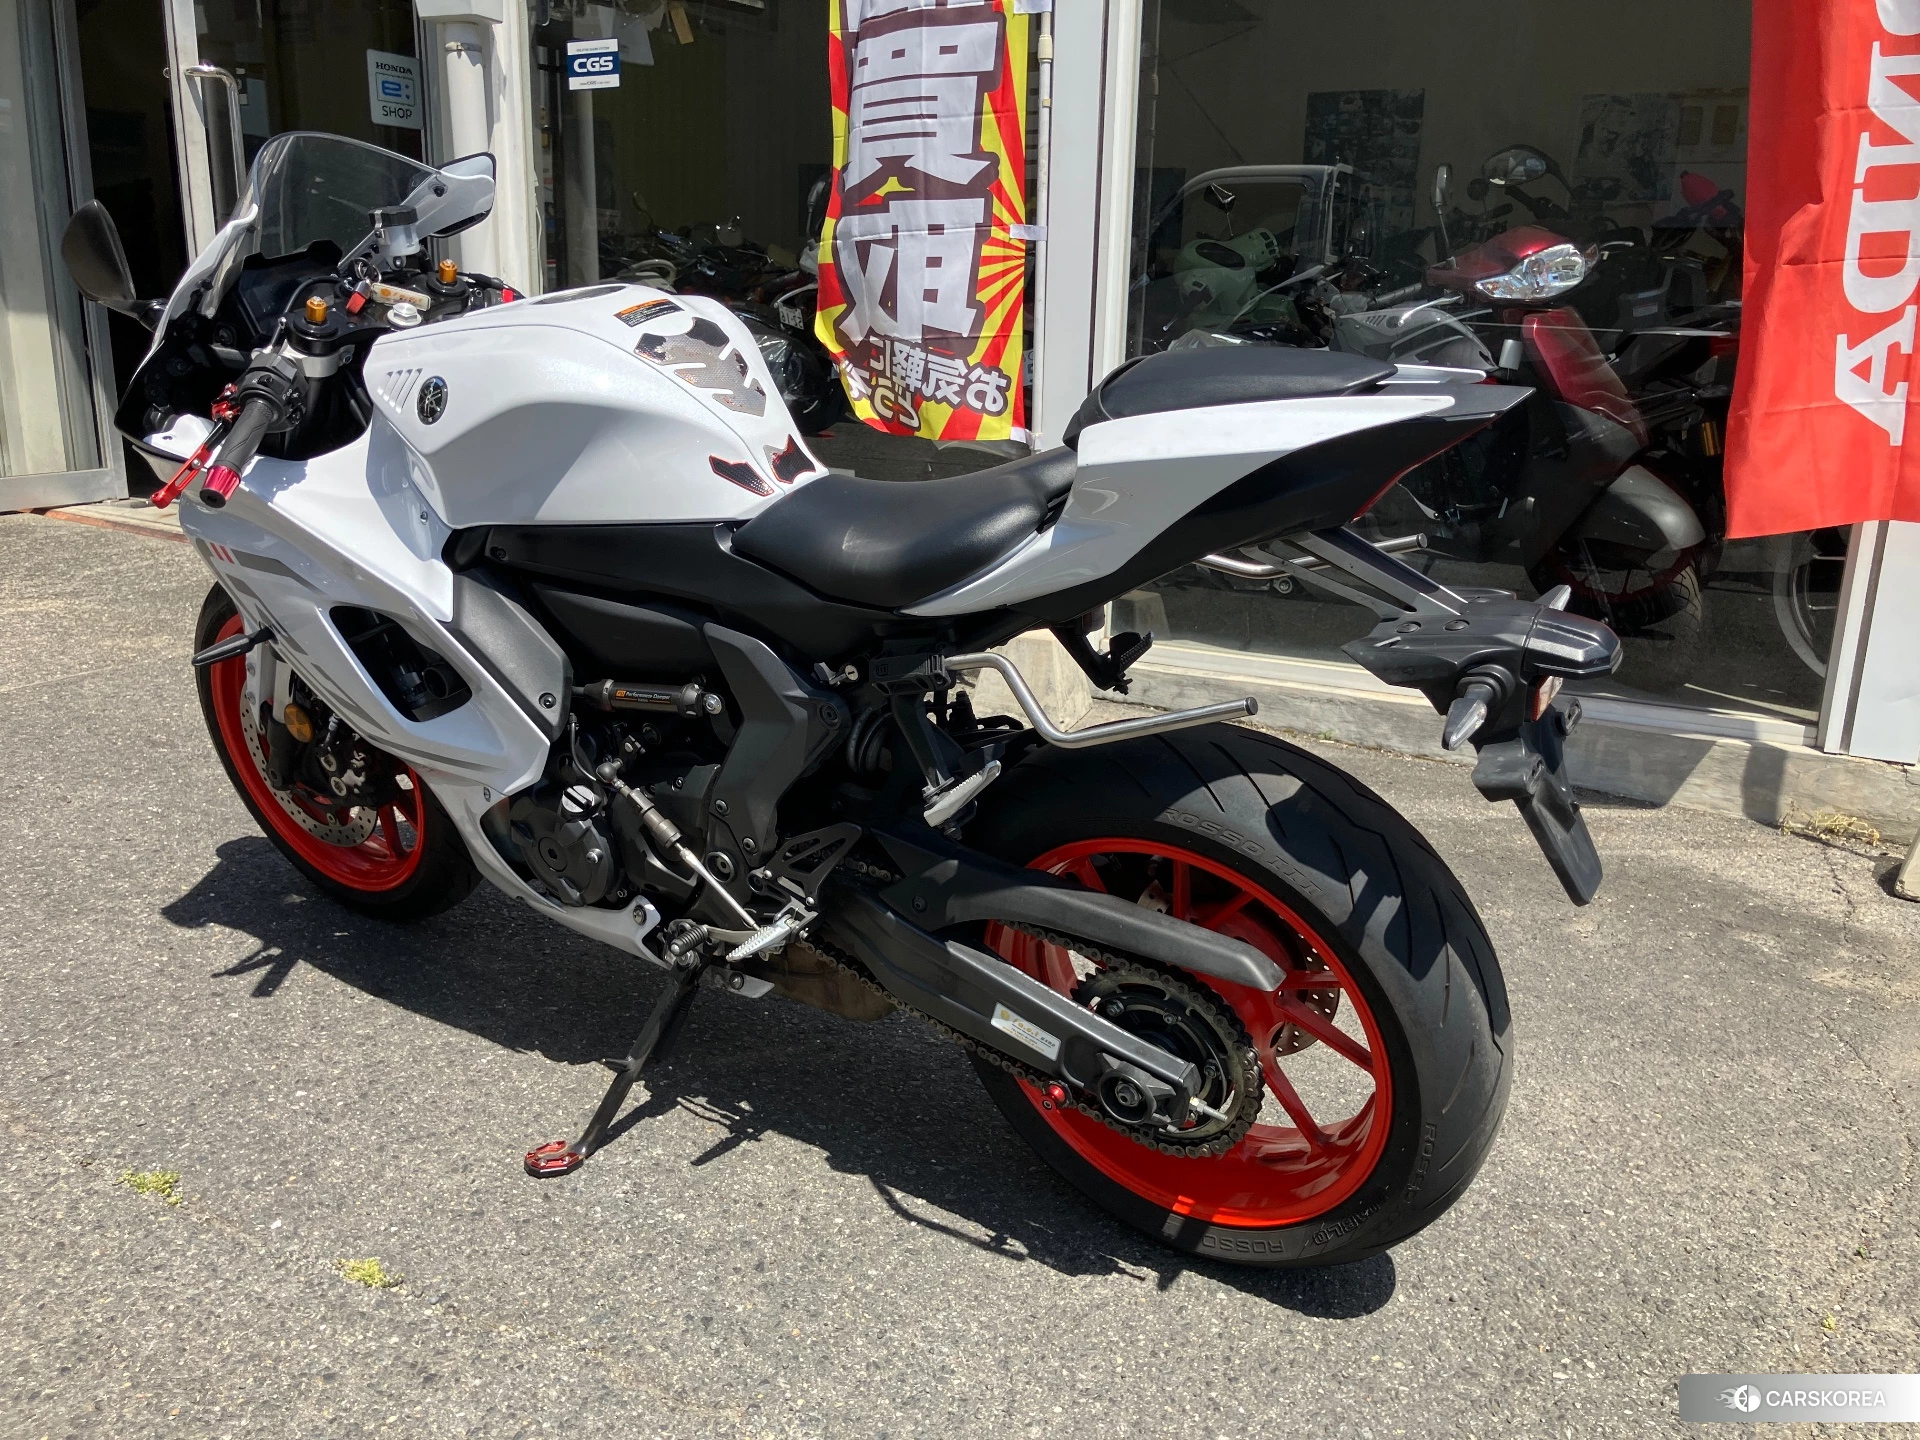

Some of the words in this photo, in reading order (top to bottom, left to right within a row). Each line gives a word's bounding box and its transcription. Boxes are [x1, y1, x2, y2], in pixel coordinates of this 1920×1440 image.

[375, 62, 413, 75] HONDA
[573, 56, 614, 73] CGS
[381, 105, 413, 119] SHOP
[1162, 808, 1265, 854] ROSSO
[1201, 1233, 1284, 1255] ROSSO
